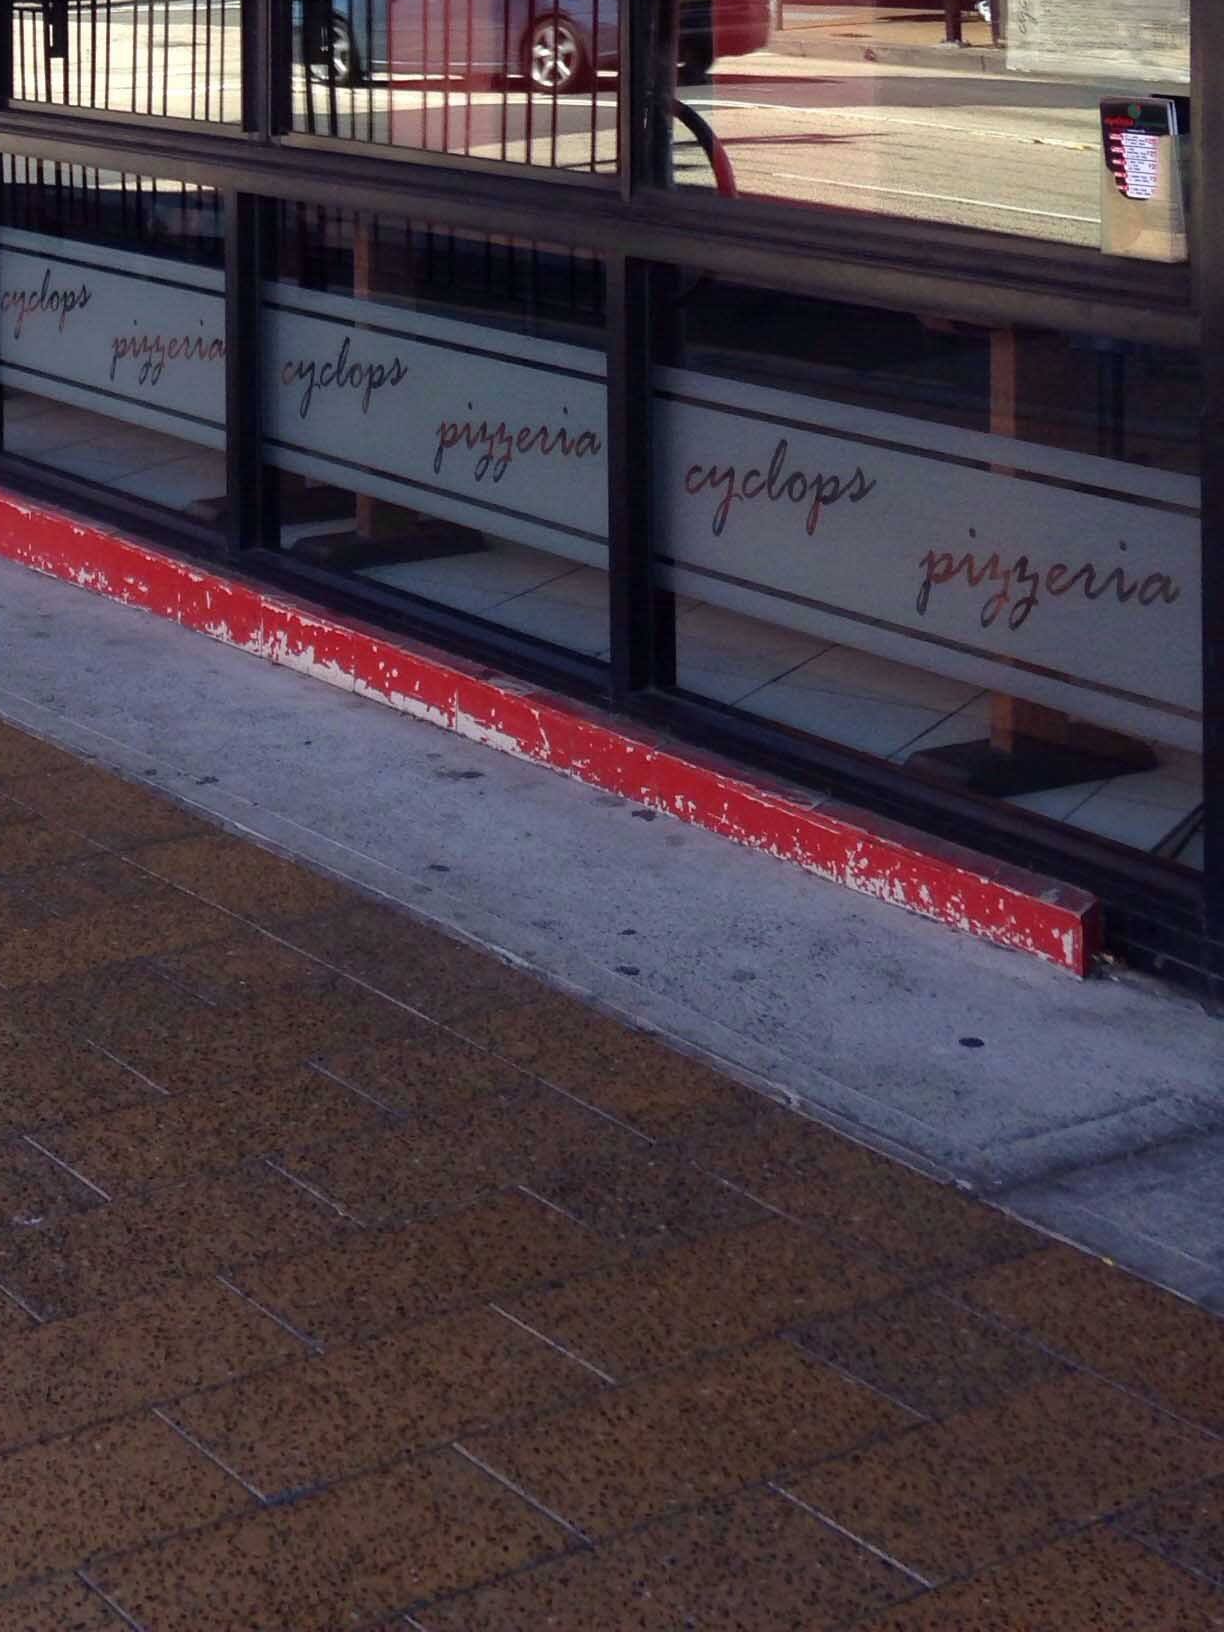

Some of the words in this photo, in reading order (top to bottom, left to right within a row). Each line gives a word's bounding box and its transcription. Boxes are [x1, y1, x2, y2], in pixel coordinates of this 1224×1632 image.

[0, 268, 92, 339] cyclops
[281, 336, 409, 419] cyclops
[433, 401, 602, 483] pizzeria
[685, 439, 876, 537] cyclops
[916, 527, 1181, 632] pizzeria
